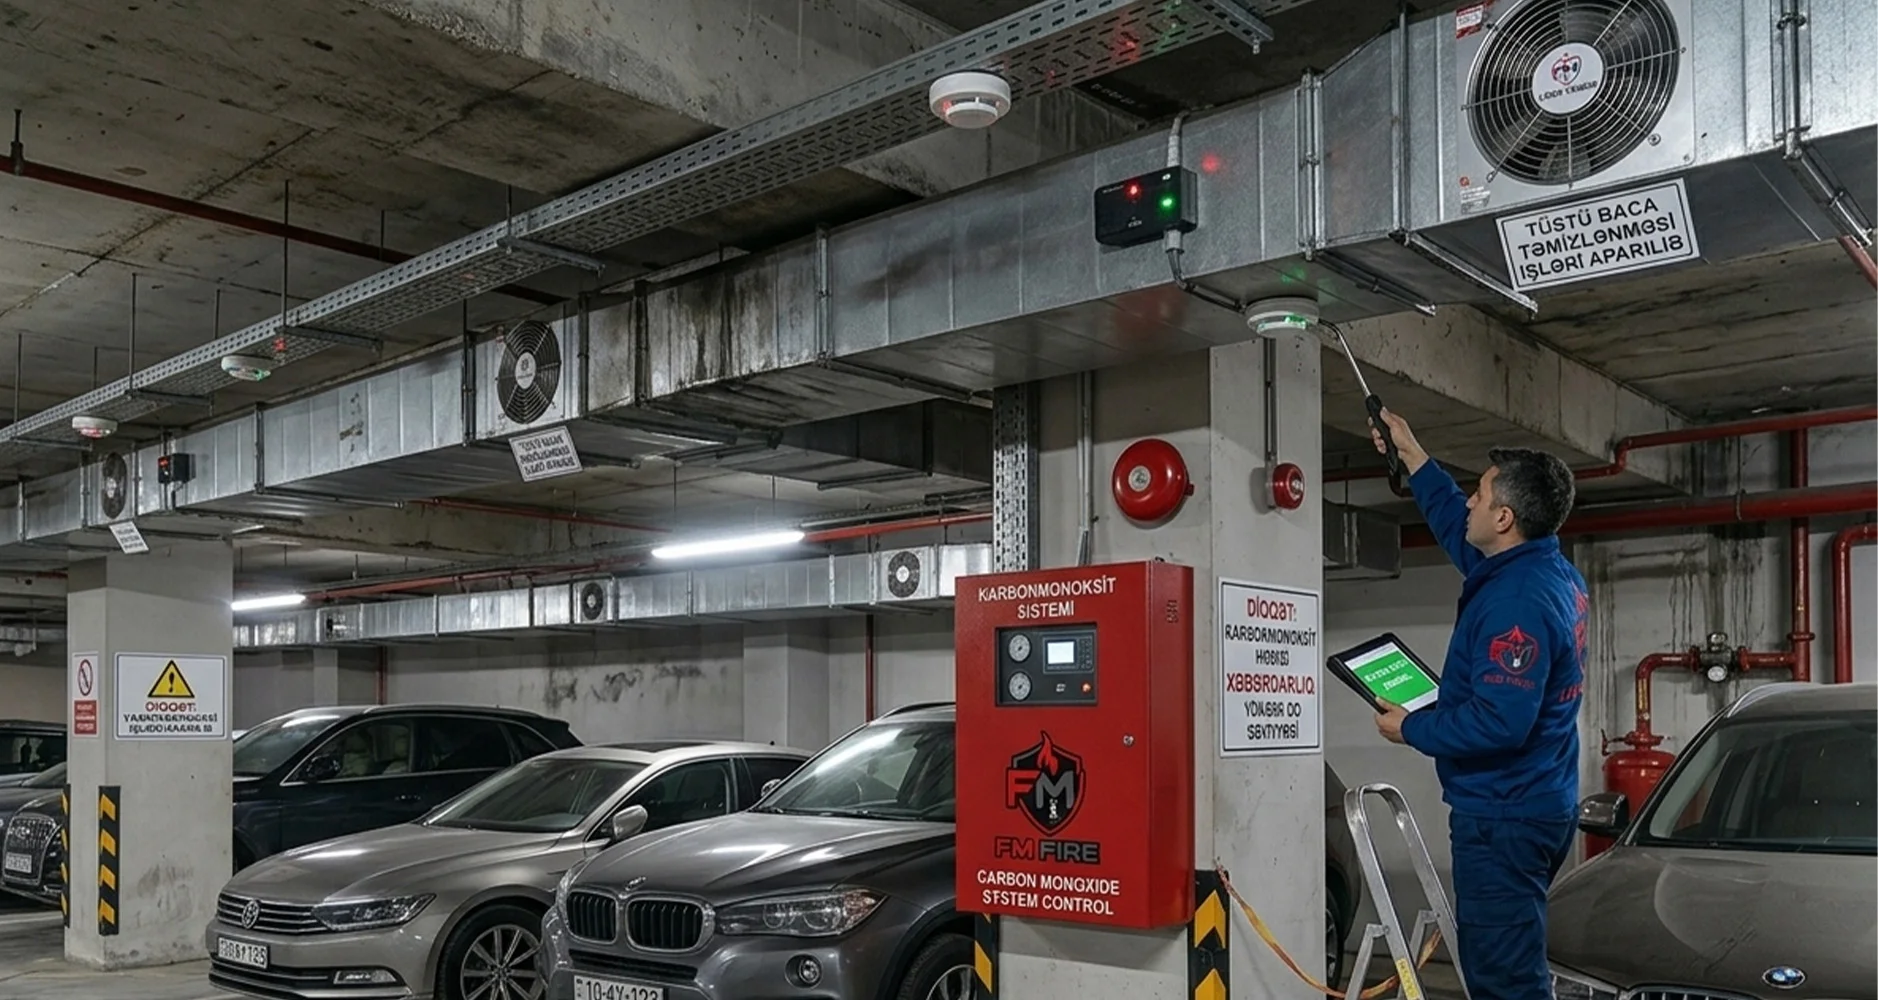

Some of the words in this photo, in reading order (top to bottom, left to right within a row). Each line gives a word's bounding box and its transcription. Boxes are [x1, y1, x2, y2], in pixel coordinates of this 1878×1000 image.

[1525, 209, 1592, 236] TÜSTÜ
[1597, 198, 1659, 223] BACA
[996, 837, 1034, 860] FM
[1039, 840, 1099, 863] FIRE
[977, 869, 1037, 888] CARBON
[1042, 894, 1114, 916] CONTROL
